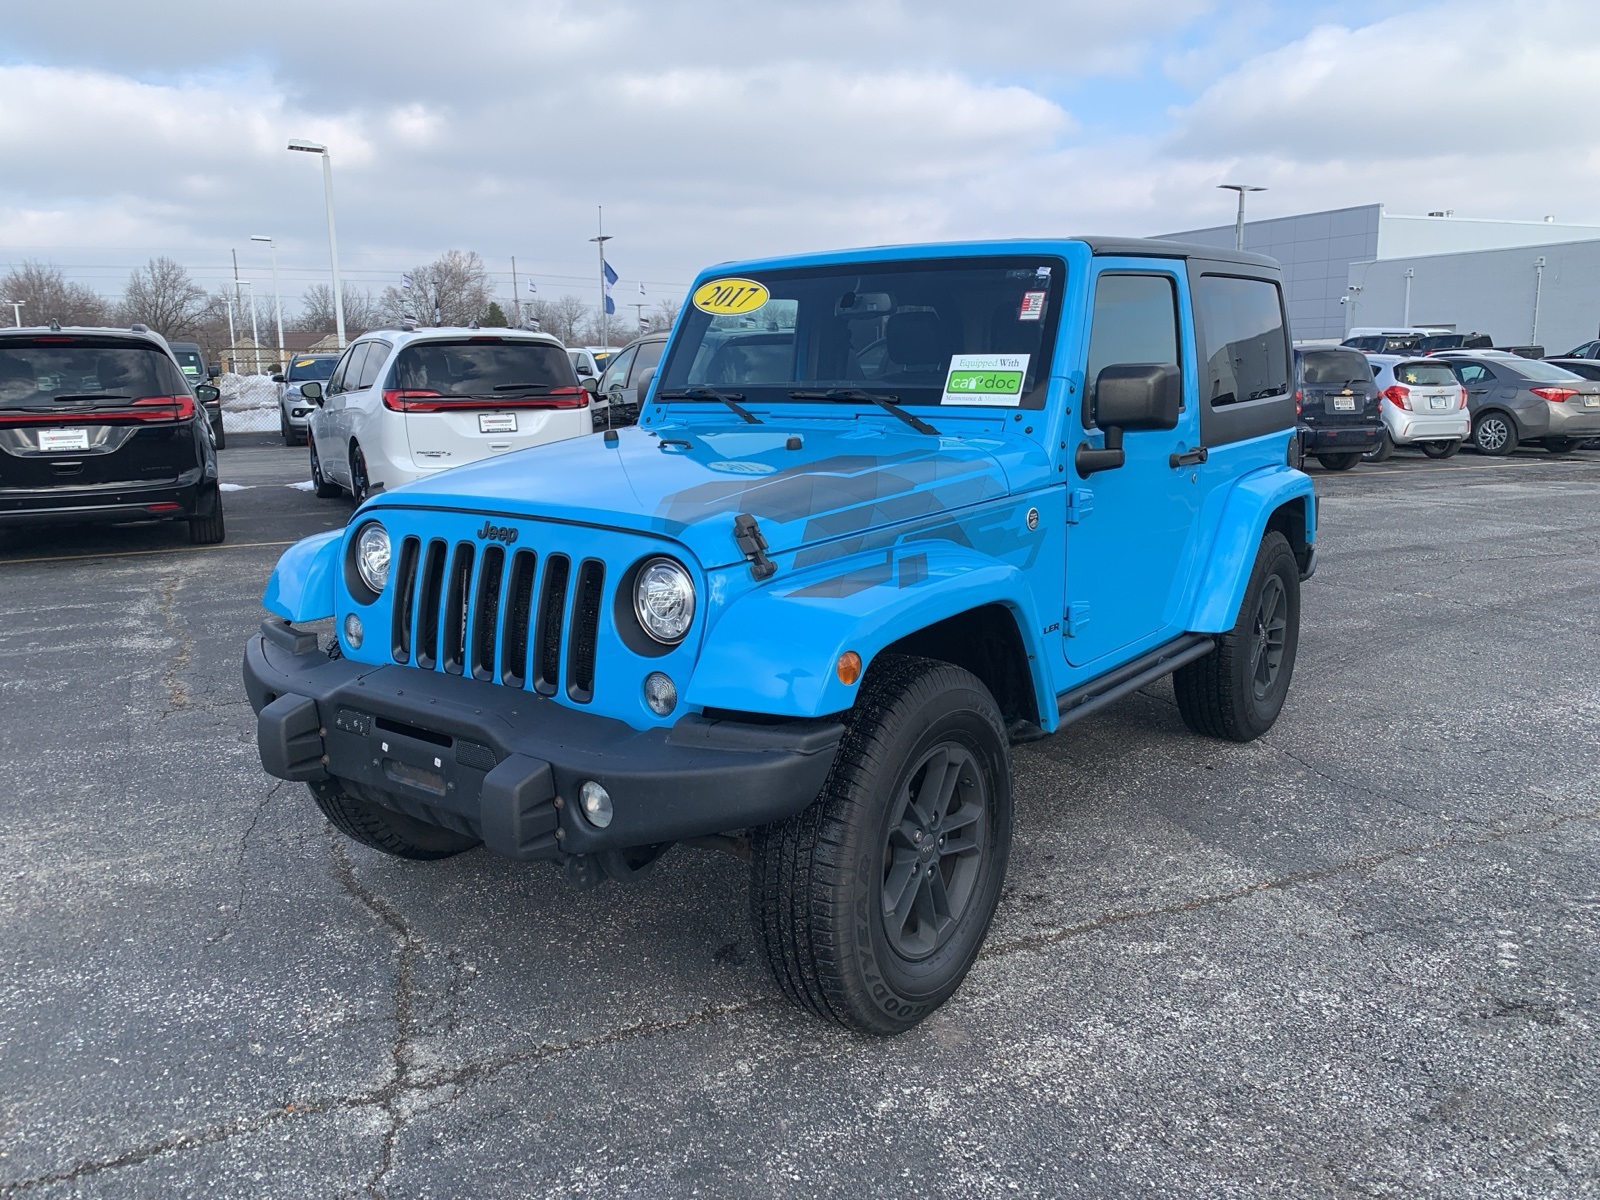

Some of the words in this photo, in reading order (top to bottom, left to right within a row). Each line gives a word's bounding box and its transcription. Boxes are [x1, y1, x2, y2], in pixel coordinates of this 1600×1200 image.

[701, 286, 760, 307] 2017
[960, 359, 998, 368] Equipped
[1000, 359, 1019, 367] With
[985, 374, 1015, 389] doc
[477, 520, 518, 546] Jeep
[856, 854, 929, 1017] GOODYEAR
